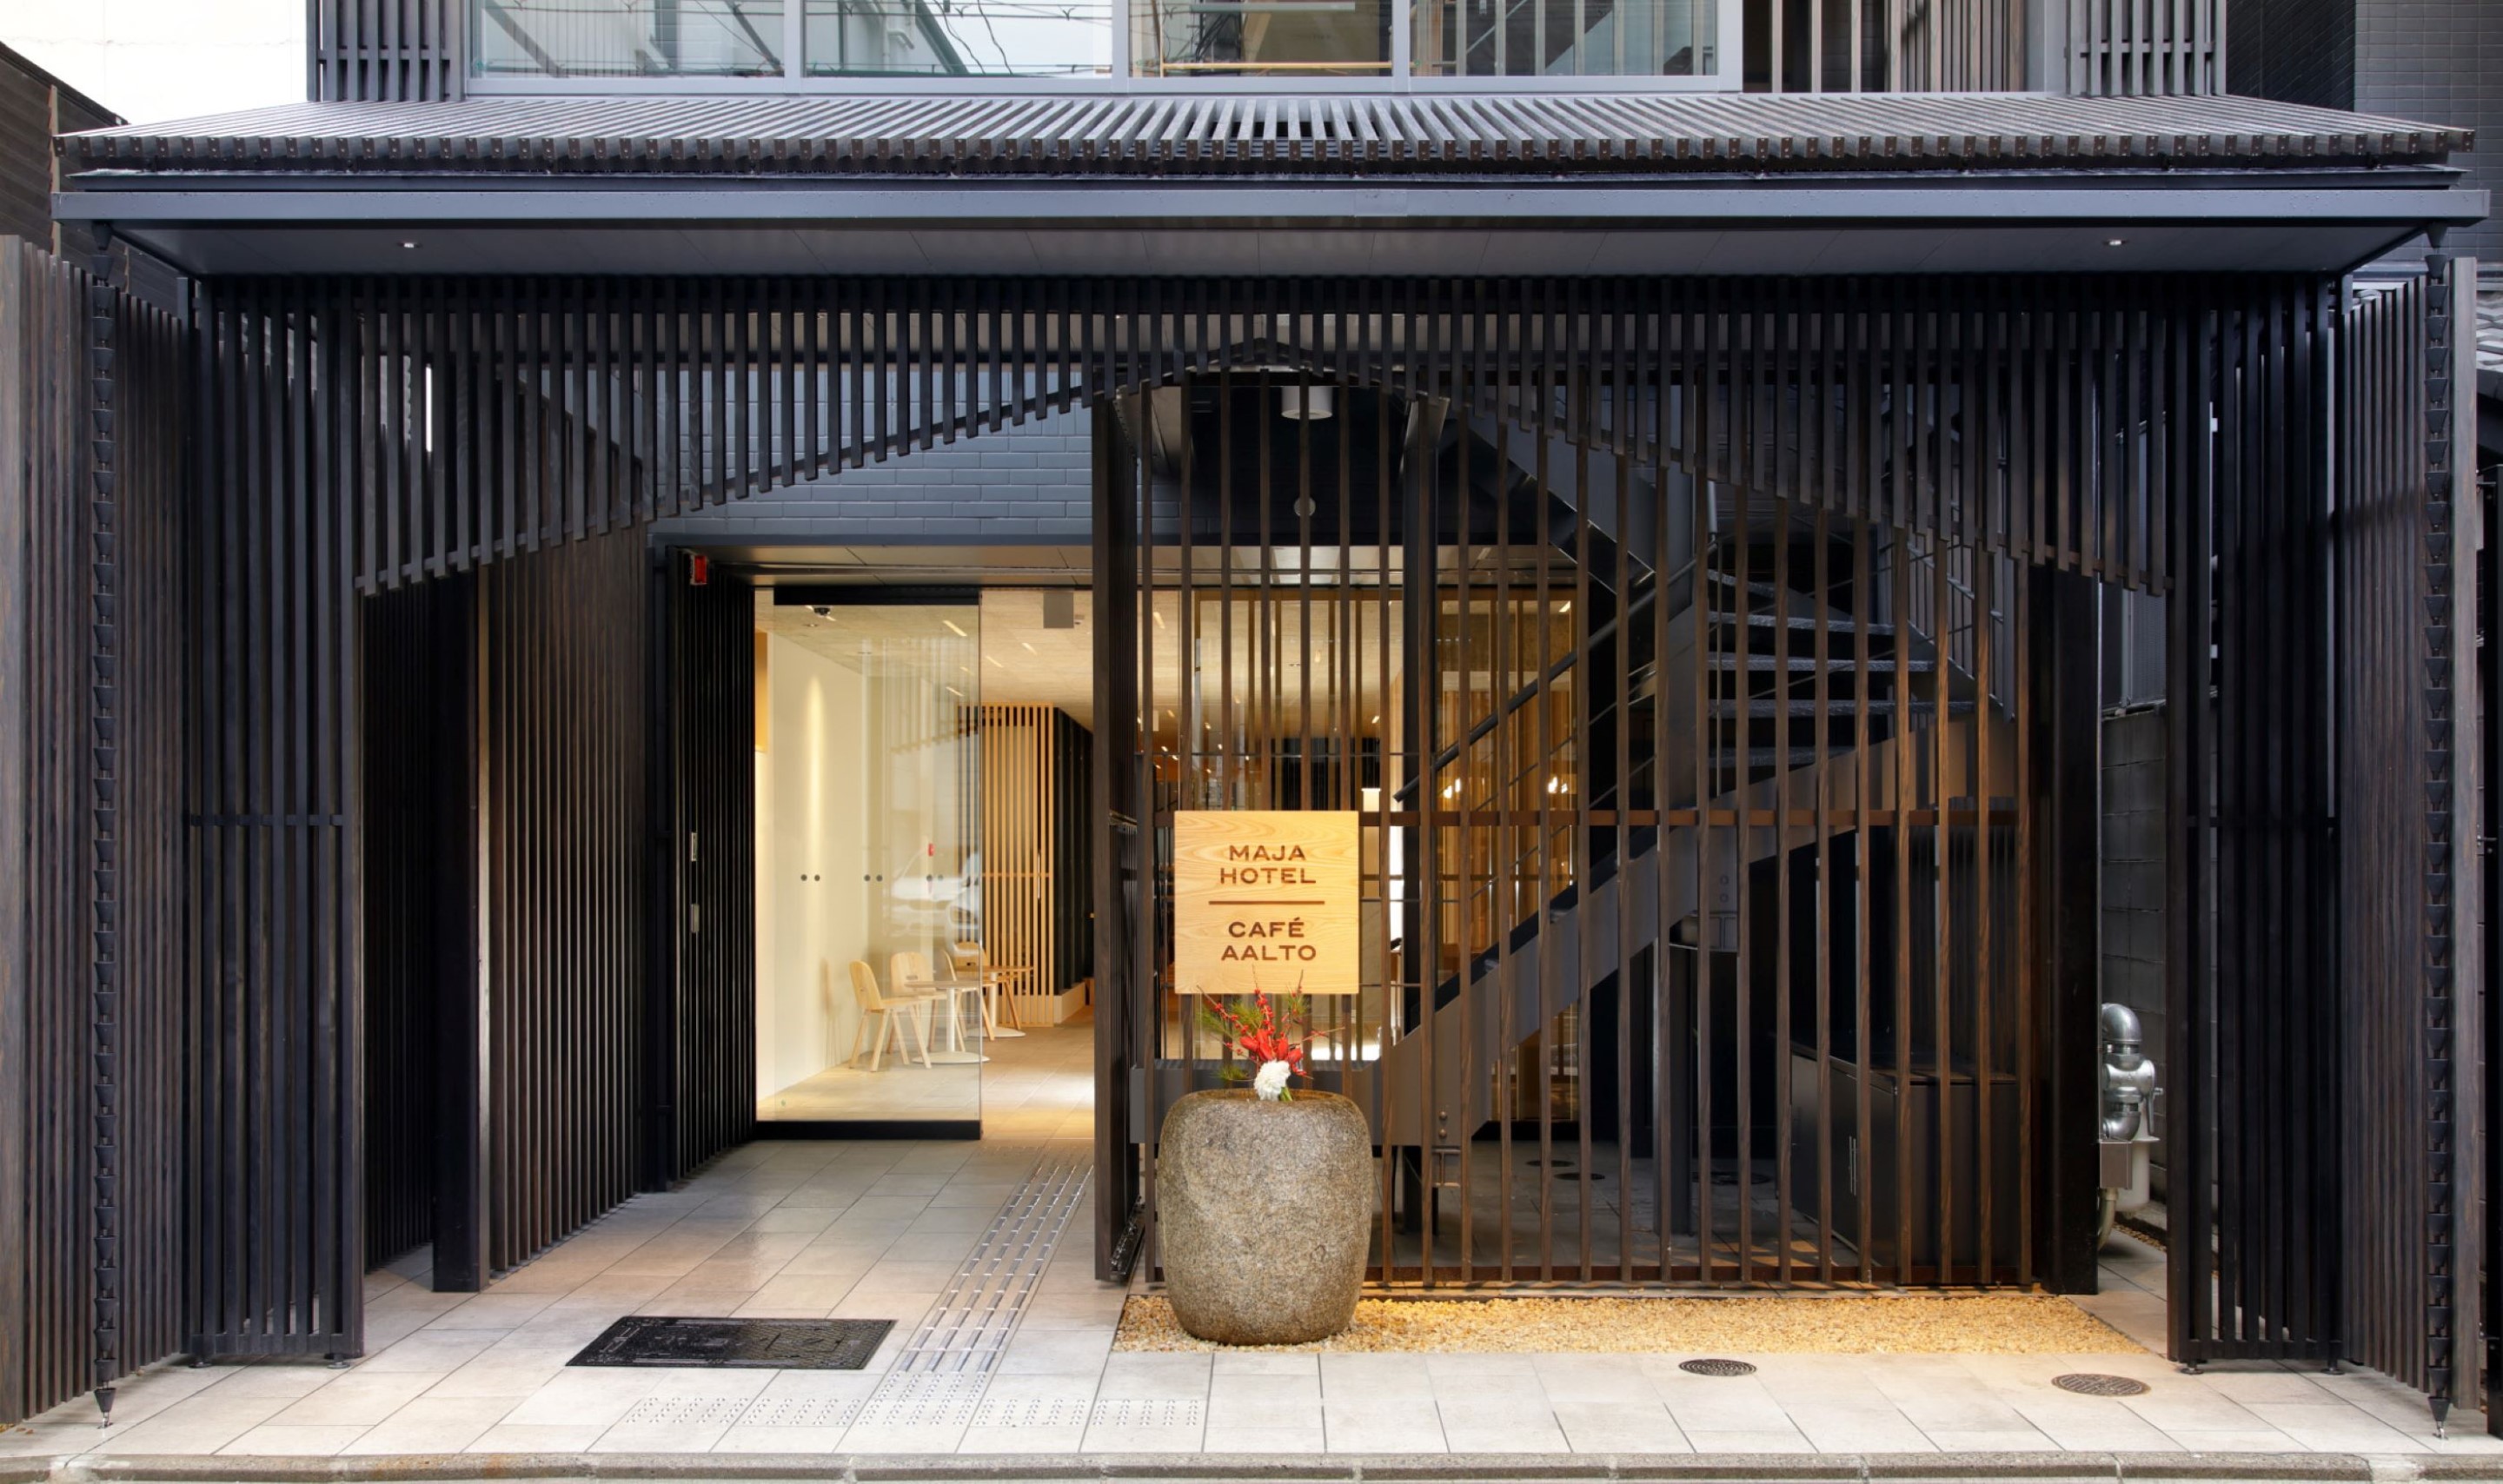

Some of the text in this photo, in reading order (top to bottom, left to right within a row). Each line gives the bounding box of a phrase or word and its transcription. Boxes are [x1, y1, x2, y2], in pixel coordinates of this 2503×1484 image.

[1229, 845, 1306, 861] MAJA
[1220, 868, 1317, 884] HOTEL
[1229, 917, 1305, 937] CAFÉ
[1221, 945, 1317, 961] AALTO
